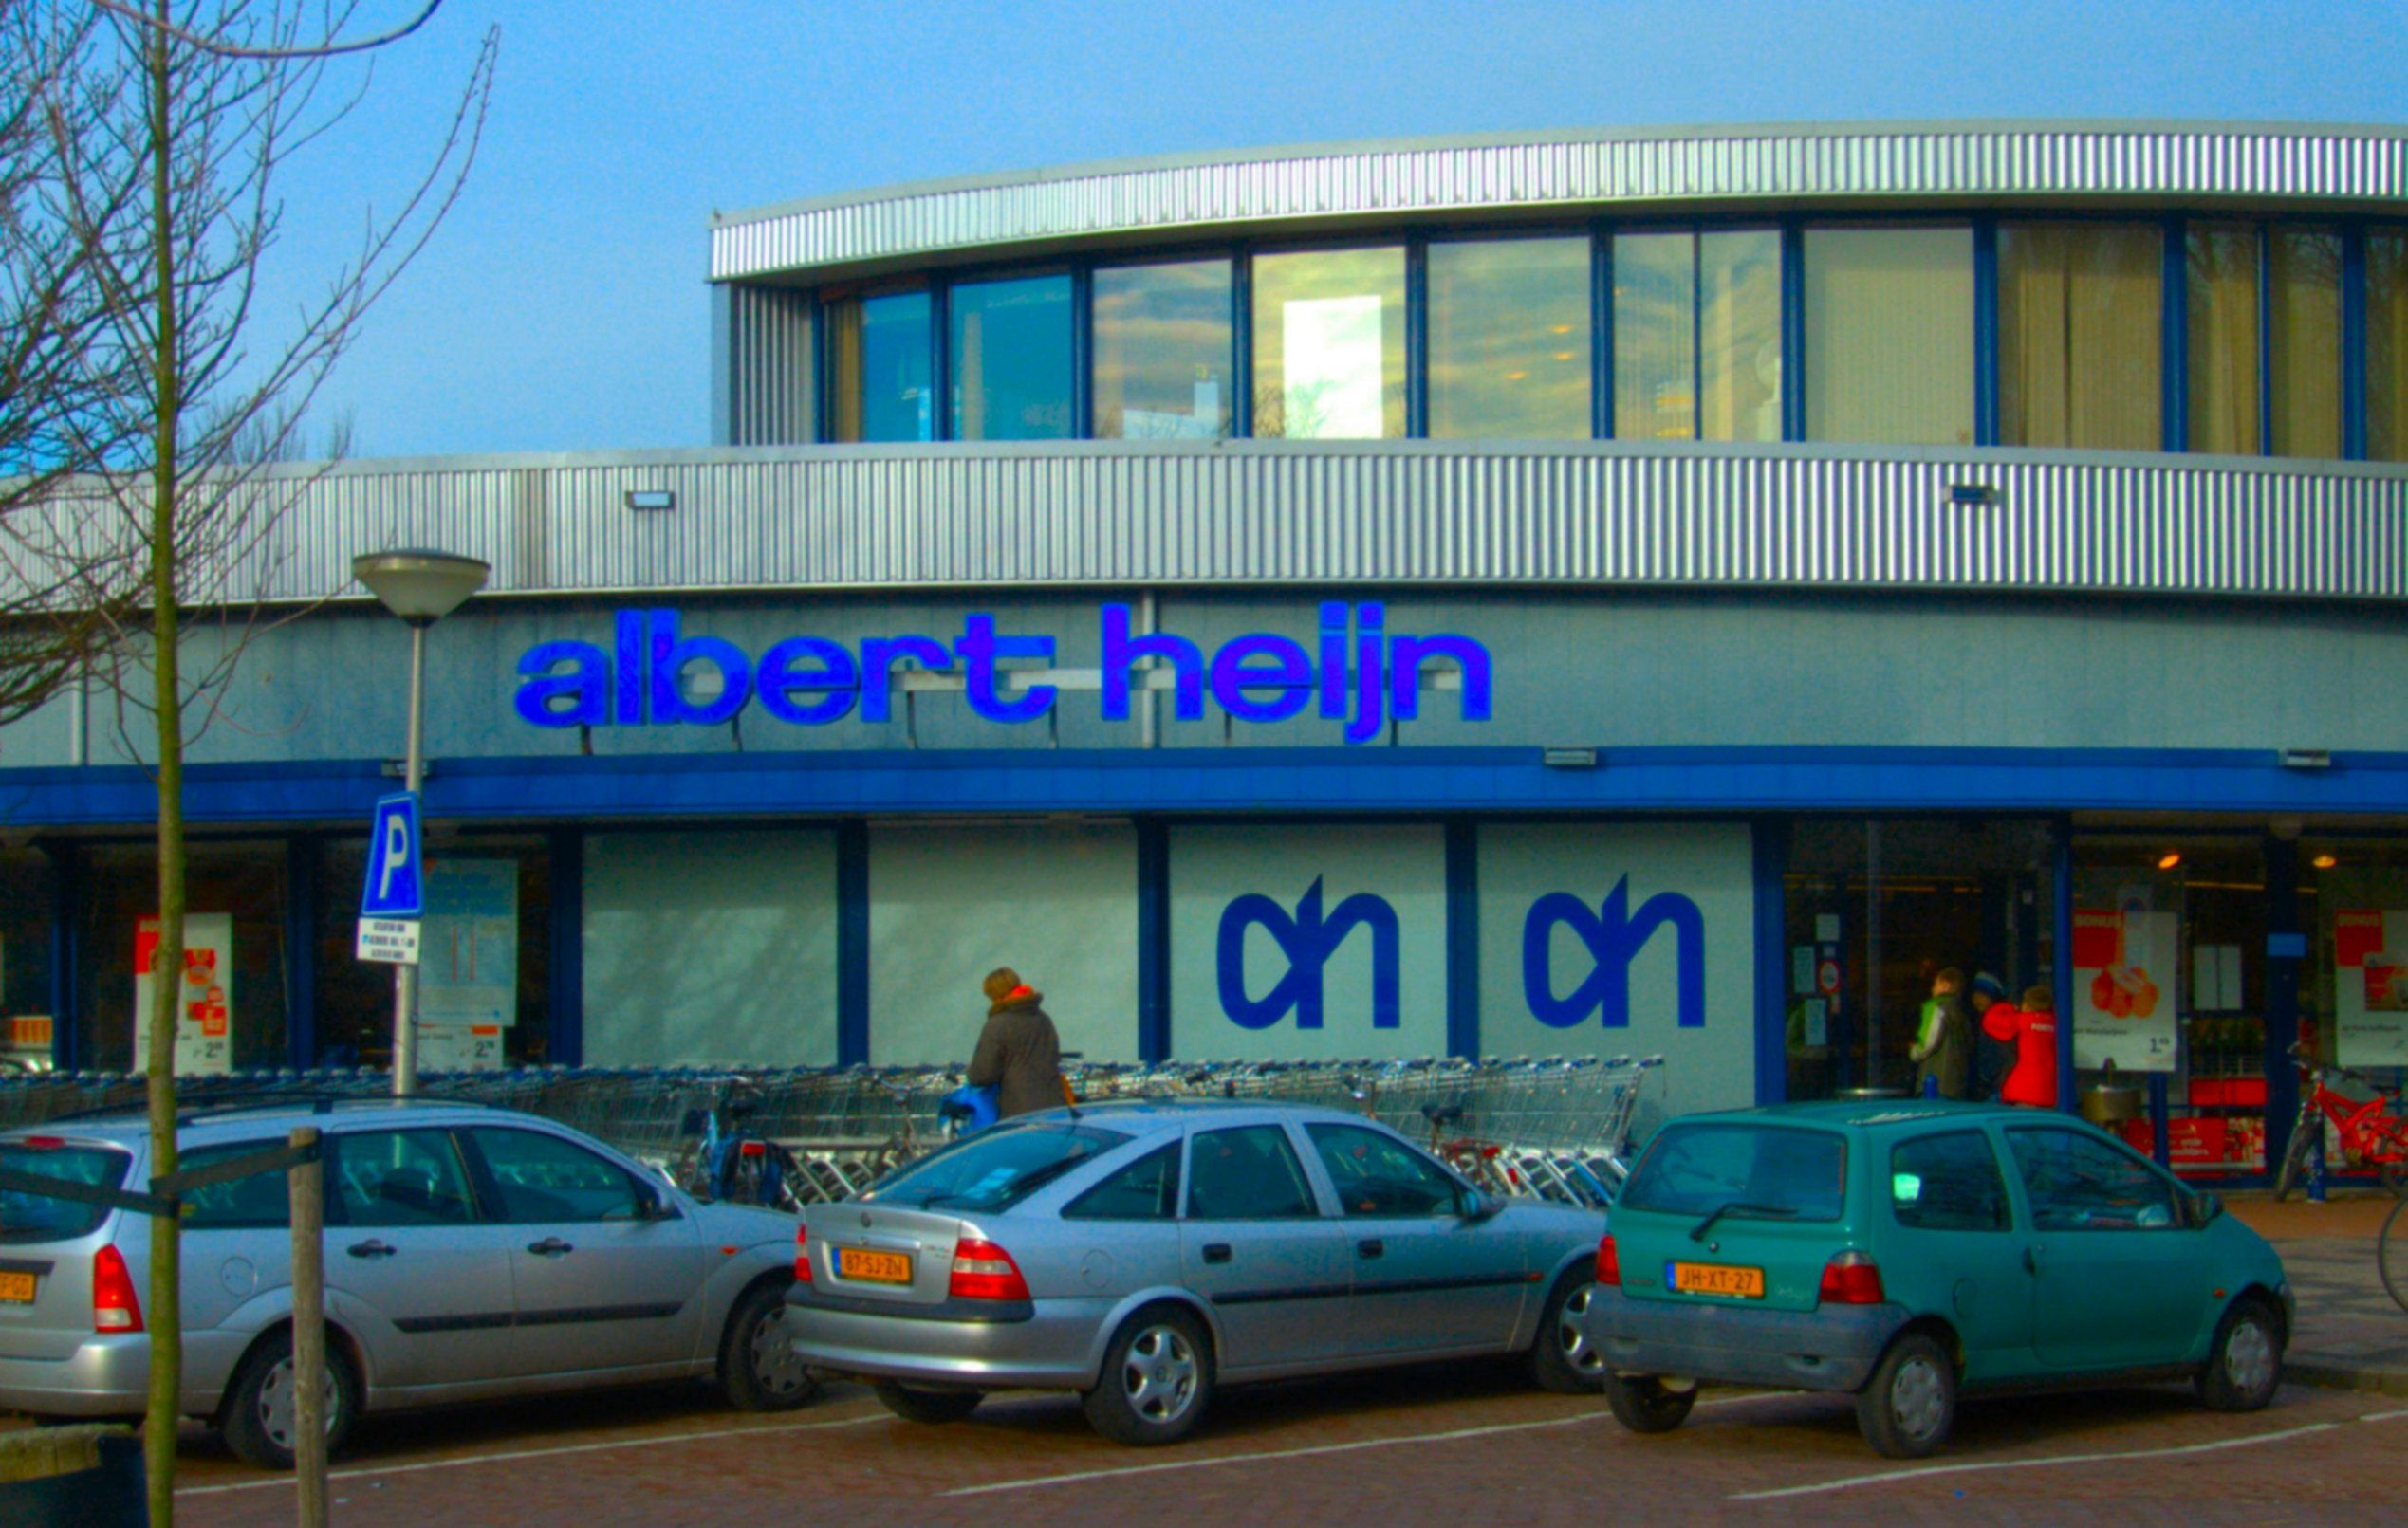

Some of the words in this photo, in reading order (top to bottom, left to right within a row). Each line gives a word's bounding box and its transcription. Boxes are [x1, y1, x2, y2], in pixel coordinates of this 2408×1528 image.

[514, 608, 1058, 727] albert
[1101, 601, 1491, 745] heijn
[378, 815, 409, 899] P
[1681, 1267, 1755, 1291] JH-XT-27
